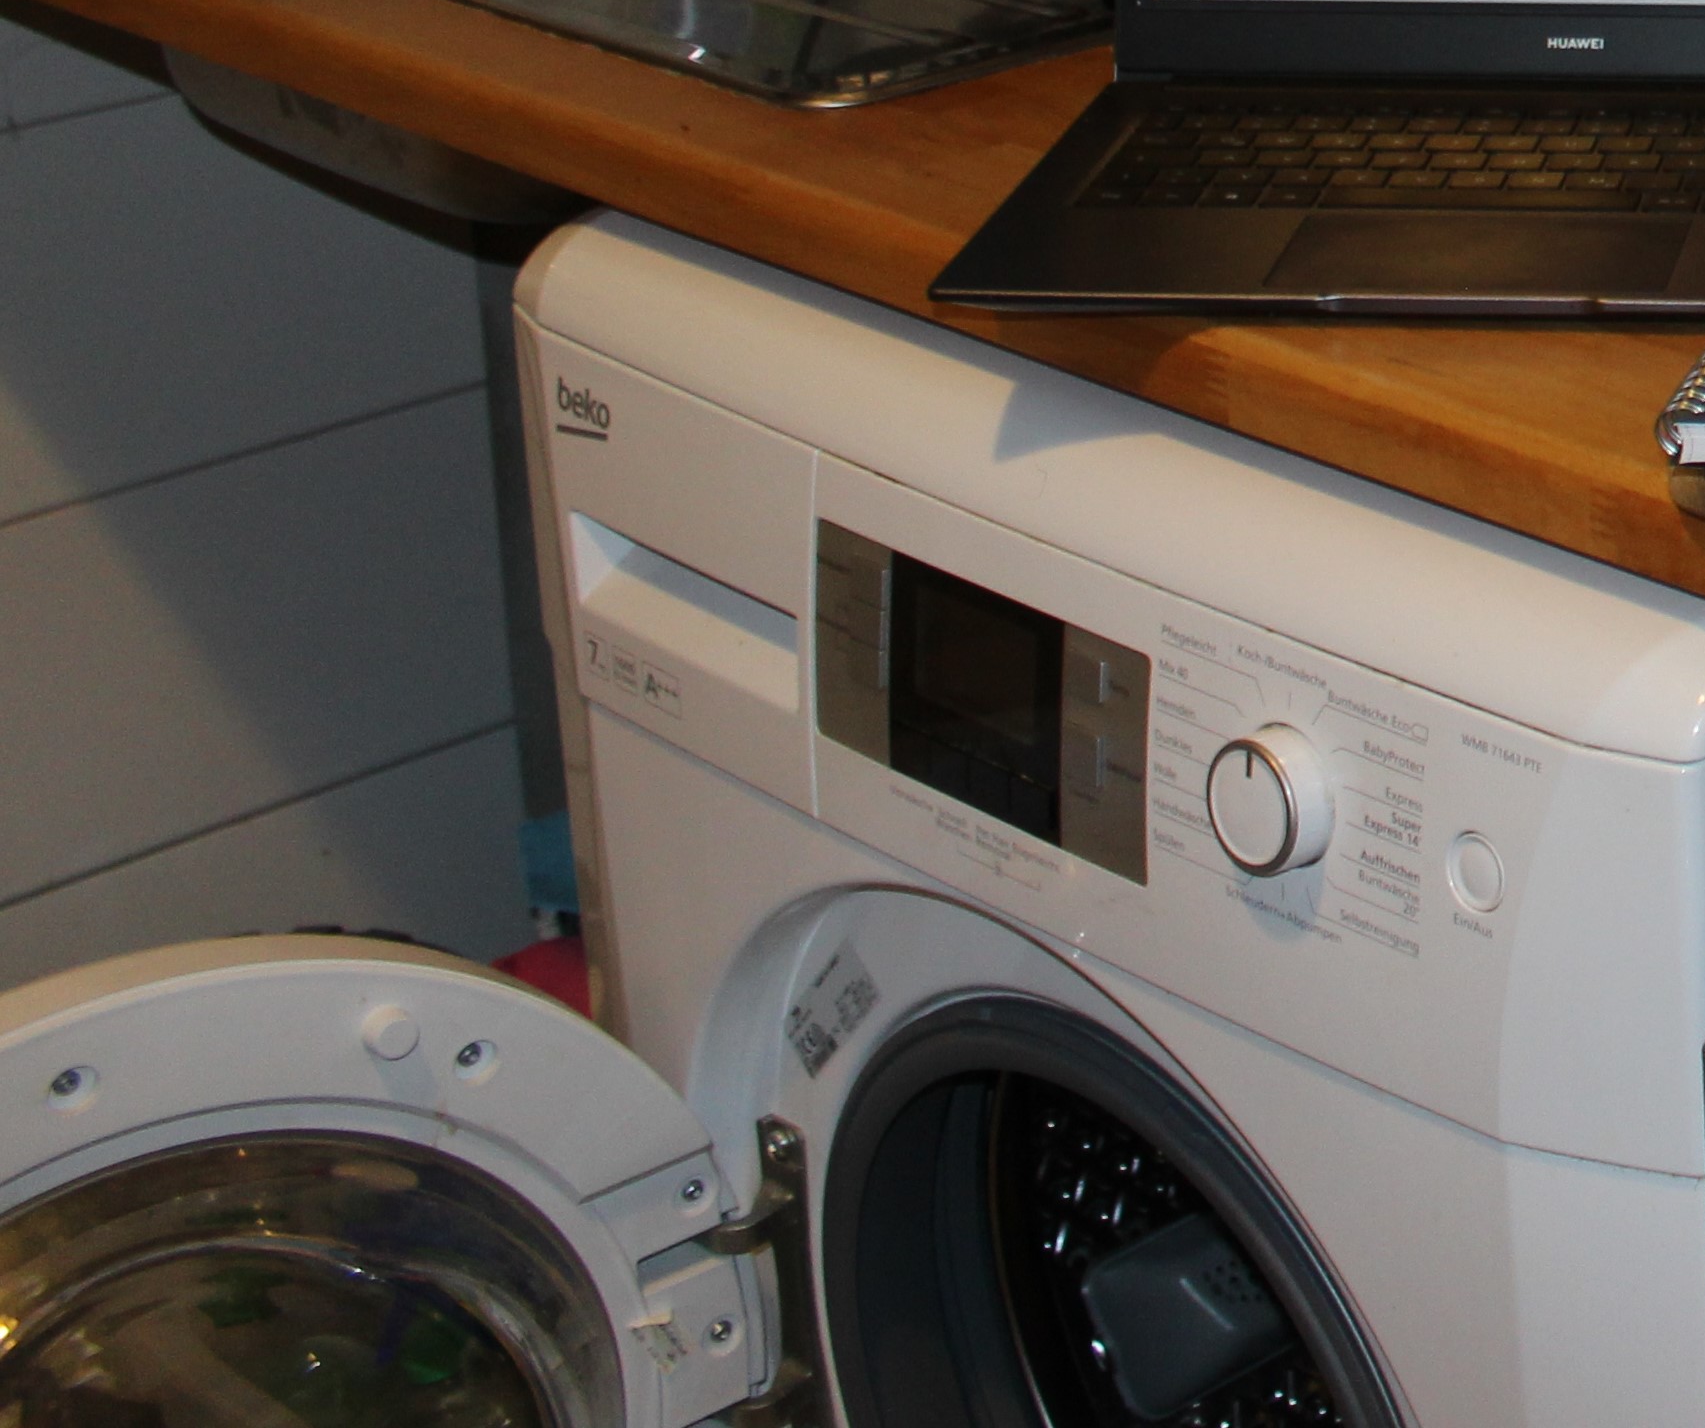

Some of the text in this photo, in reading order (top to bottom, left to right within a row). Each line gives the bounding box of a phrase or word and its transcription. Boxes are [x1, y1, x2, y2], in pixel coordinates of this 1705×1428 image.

[1546, 37, 1605, 50] HUAWEI
[557, 376, 610, 429] beko
[1362, 740, 1426, 775] BabyProtect
[1453, 912, 1494, 940] Ein/Aus
